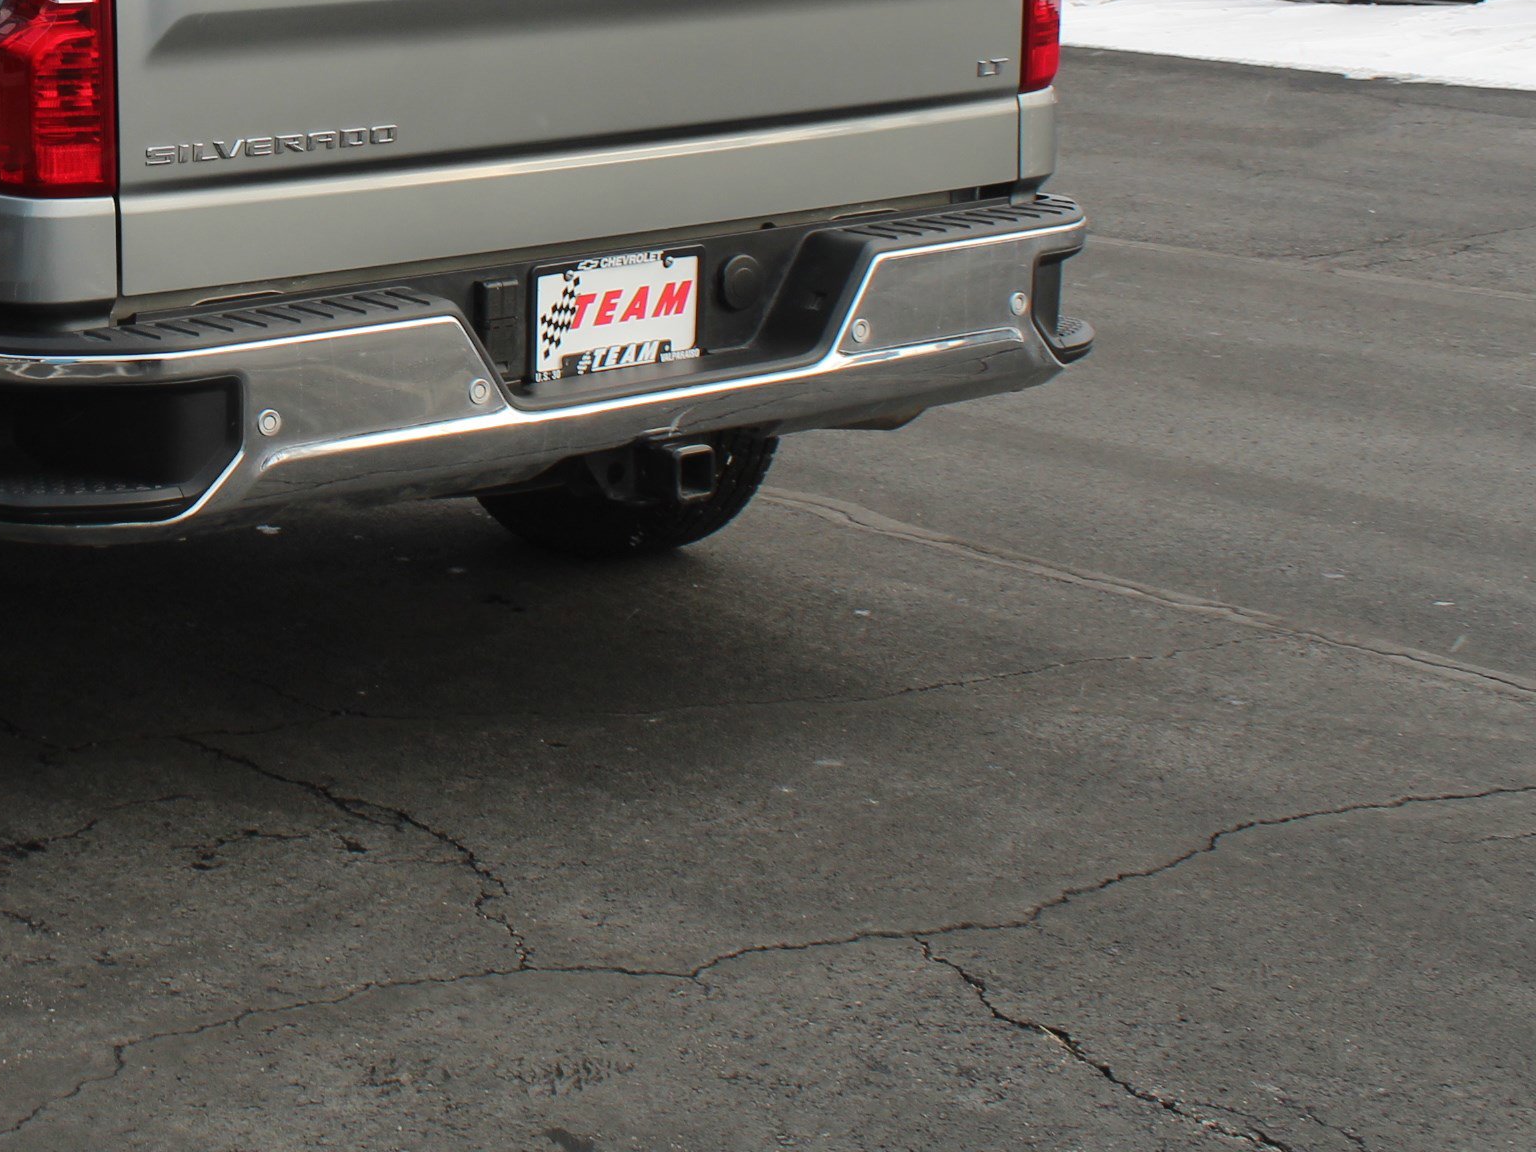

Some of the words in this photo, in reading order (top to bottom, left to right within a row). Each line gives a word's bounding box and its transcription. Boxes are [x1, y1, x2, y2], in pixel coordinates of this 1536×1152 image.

[977, 57, 1010, 78] LT
[145, 124, 398, 167] SILVERADO
[599, 250, 664, 269] CHEVROLET
[570, 280, 693, 329] TEAM
[591, 340, 660, 368] TEAM
[660, 348, 701, 363] VALPARAISO
